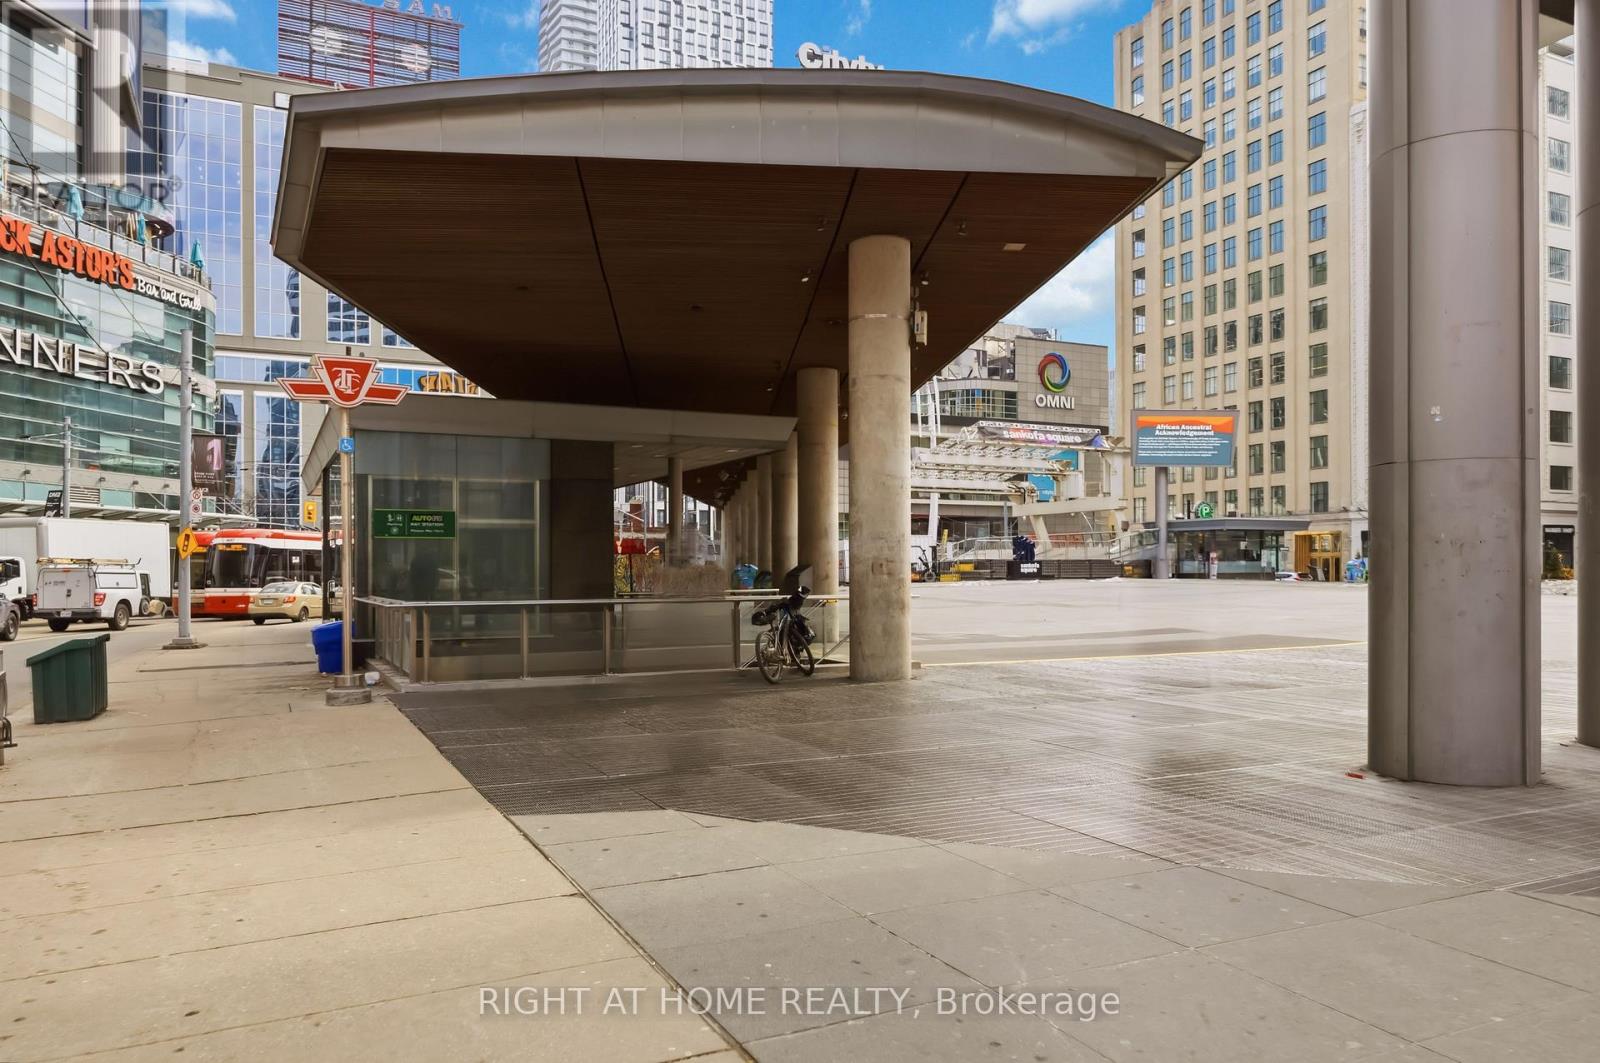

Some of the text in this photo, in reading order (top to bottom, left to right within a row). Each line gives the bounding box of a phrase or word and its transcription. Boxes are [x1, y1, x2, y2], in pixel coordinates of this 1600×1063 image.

[40, 230, 136, 290] ASTOR'S
[137, 277, 202, 311] Bar and Grill
[1035, 393, 1076, 410] OMNI
[1002, 430, 1082, 444] sankofa square
